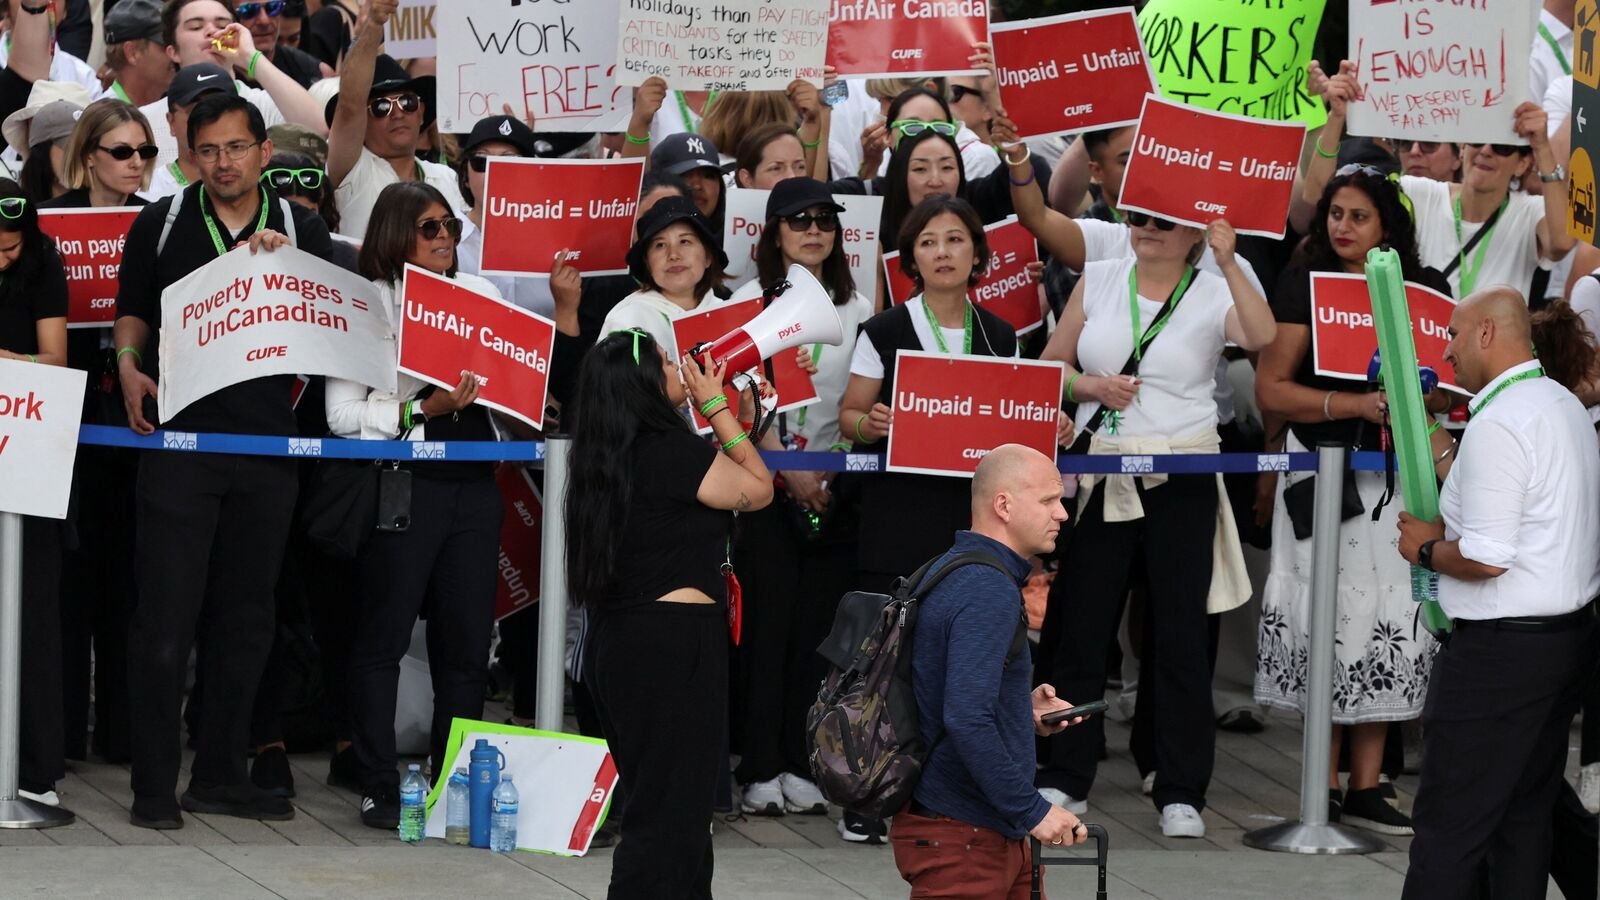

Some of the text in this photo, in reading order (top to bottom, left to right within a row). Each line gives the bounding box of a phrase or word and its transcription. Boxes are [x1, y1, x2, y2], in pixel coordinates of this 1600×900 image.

[712, 5, 751, 24] than
[758, 6, 786, 24] PAY
[903, 0, 986, 19] Canada
[625, 19, 721, 42] ATTENDANTS
[726, 27, 748, 45] for
[753, 27, 777, 43] the
[1404, 8, 1434, 39] IS
[467, 15, 580, 56] Work
[622, 36, 796, 69] CRITICAL tasks they DO
[891, 48, 923, 60] CUPE
[1370, 43, 1487, 82] ENOUGH
[624, 58, 671, 77] before
[678, 64, 735, 78] TAKEOFF
[739, 67, 761, 79] and
[765, 67, 793, 79] after
[997, 46, 1141, 89] Unpaid = Unfair
[703, 81, 748, 91] #SHAME
[1063, 103, 1093, 118] CUPE
[1369, 88, 1477, 112] WE DESERVE
[1387, 107, 1462, 129] FAIR PAY
[1137, 134, 1297, 182] Unpaid = Unfair
[489, 196, 637, 223] Unpaid = Unfair
[1194, 200, 1228, 216] CUPE
[975, 266, 1033, 303] respect
[90, 298, 116, 309] SCFP
[182, 273, 369, 330] Poverty wages =
[197, 301, 348, 347] UnCanadian
[778, 322, 802, 340] PYLE
[406, 299, 547, 375] UnfAir Canada
[246, 345, 288, 362] CUPE
[898, 391, 1057, 423] Unpaid = Unfair
[164, 437, 197, 450] YVR
[288, 443, 322, 456] YVR
[412, 447, 446, 459] YVR
[846, 460, 878, 471] YVR
[1121, 461, 1153, 473] YVR
[1257, 460, 1289, 472] YVR
[513, 500, 535, 527] CUPE
